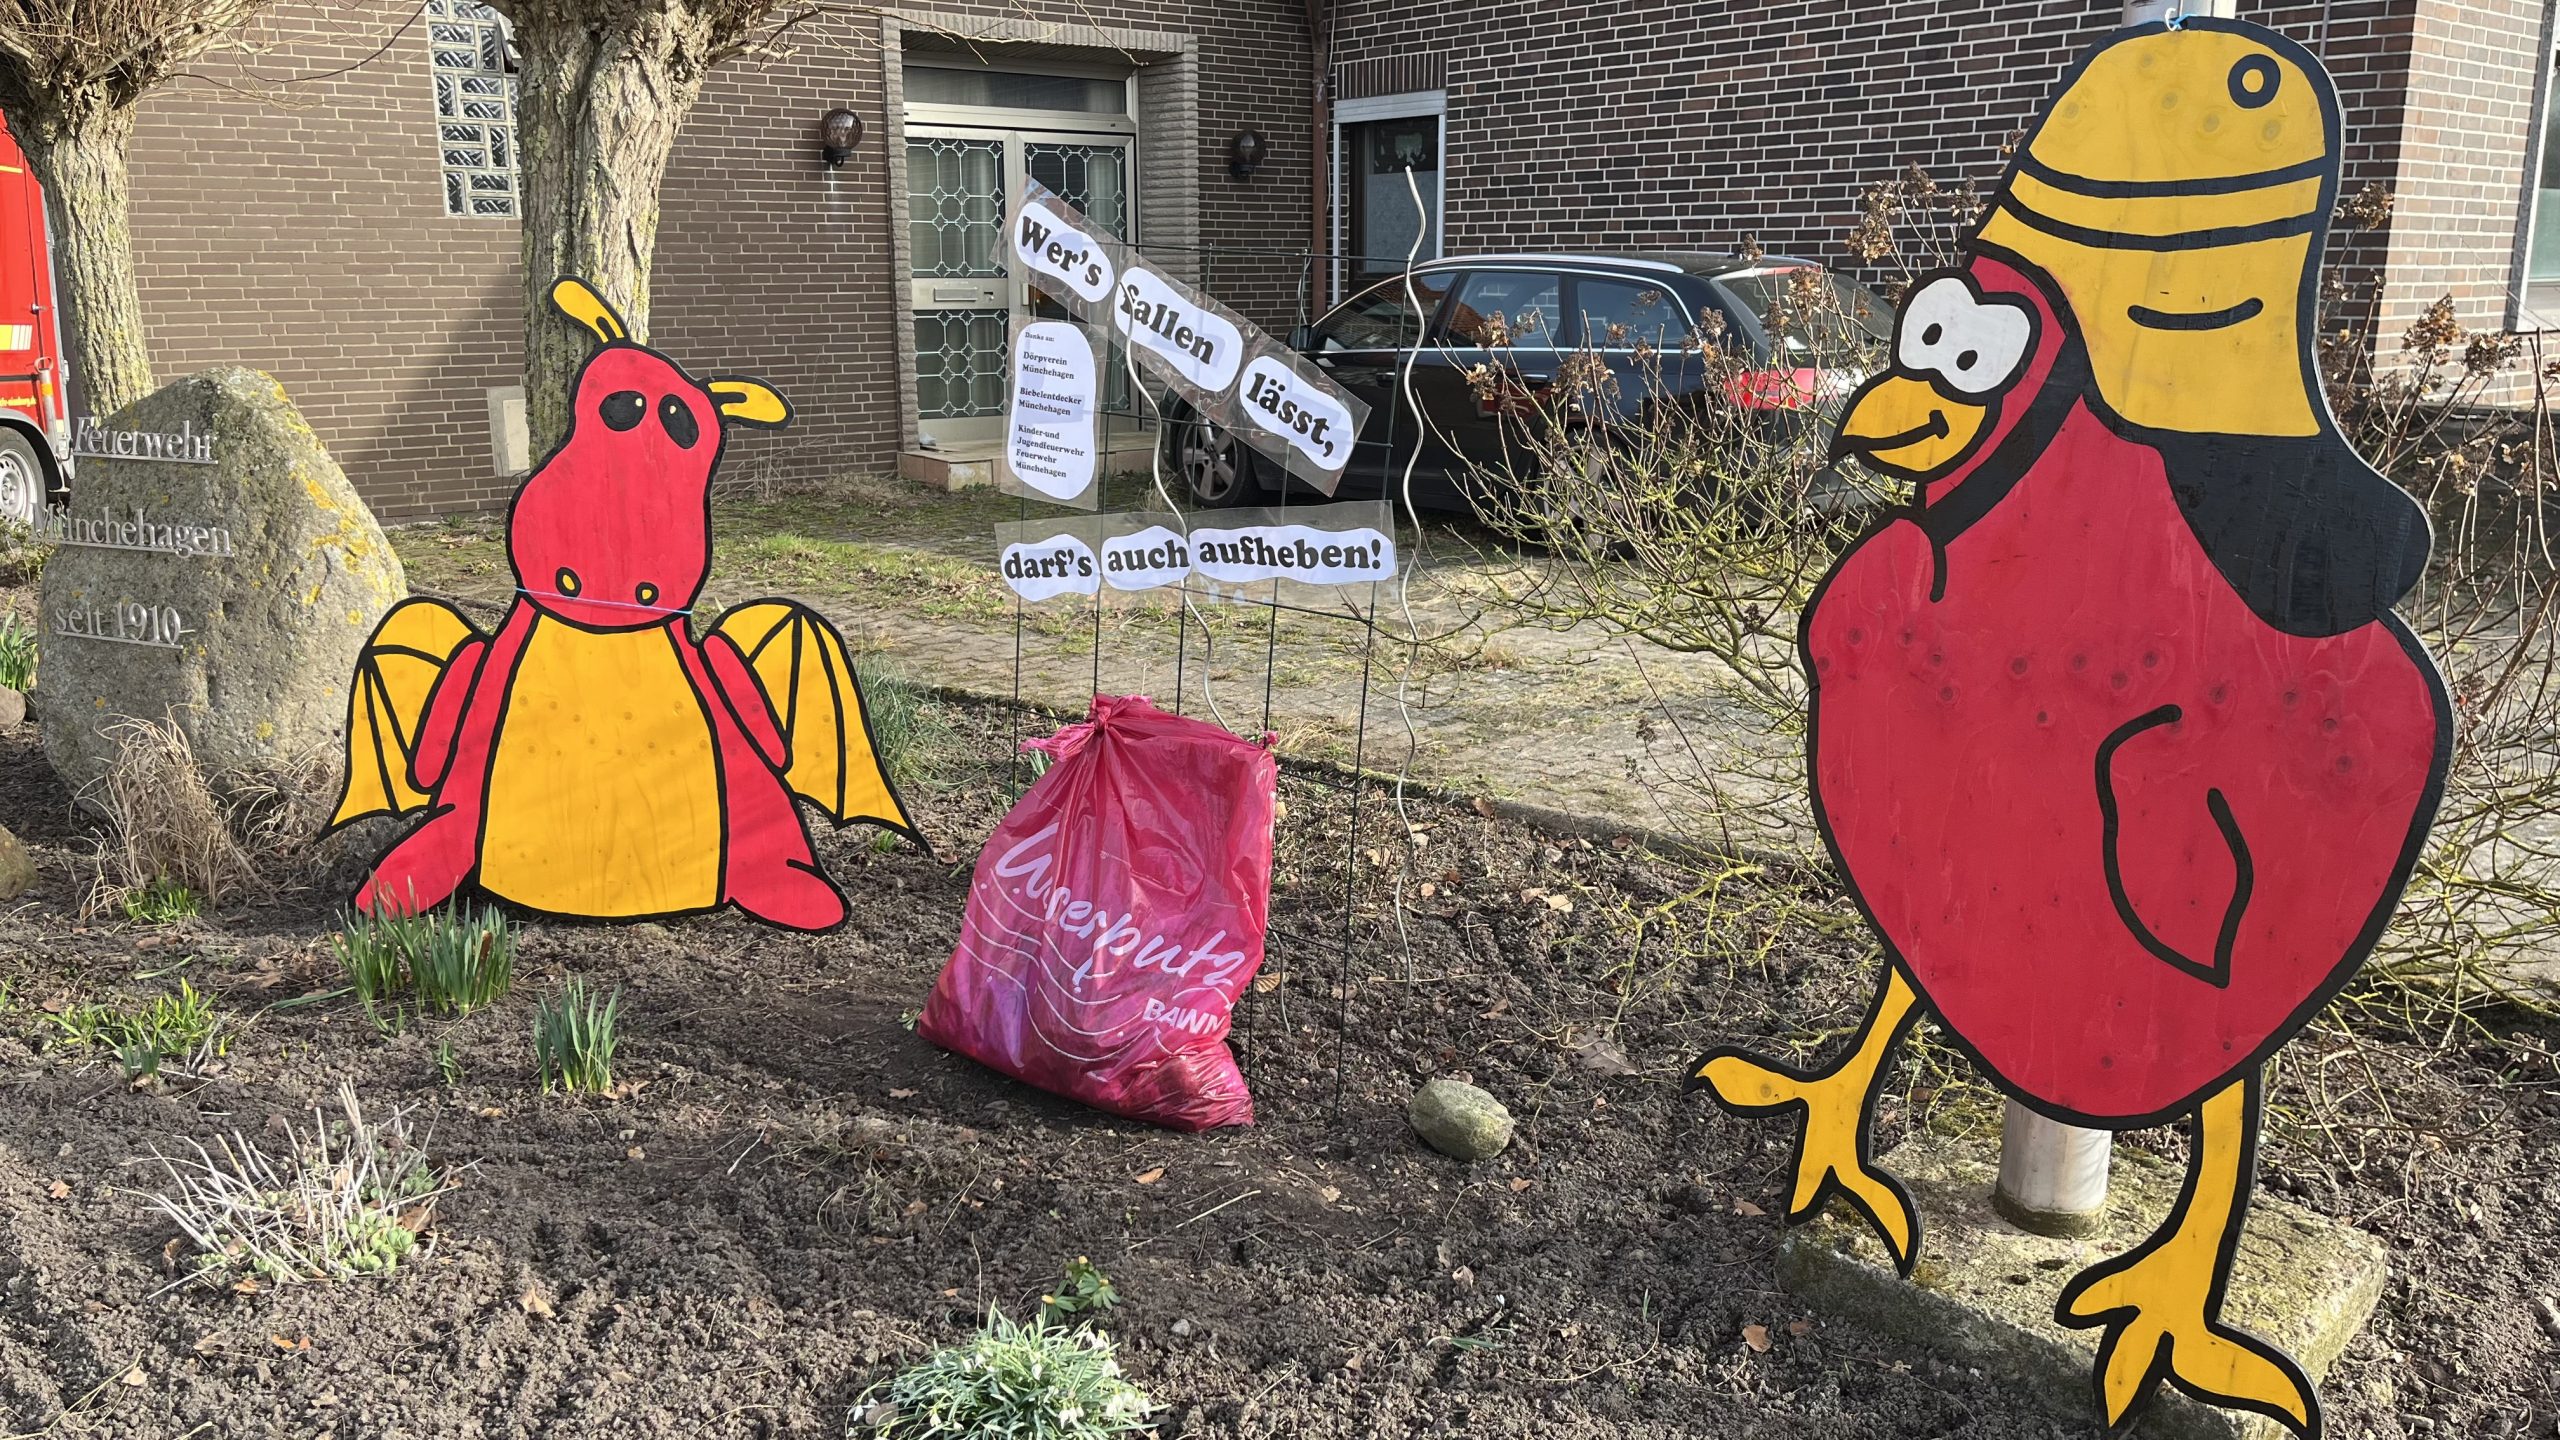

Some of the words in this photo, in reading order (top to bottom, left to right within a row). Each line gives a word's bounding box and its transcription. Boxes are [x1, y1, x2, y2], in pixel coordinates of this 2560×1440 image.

[1021, 215, 1102, 287] Wer's
[1120, 284, 1214, 365] fallen
[1246, 372, 1334, 458] lässt,
[1023, 351, 1067, 366] Dörpverein
[1022, 363, 1075, 379] Münchehagen
[1020, 386, 1082, 405] Biebelentdecker
[1018, 399, 1071, 416] Münchehagen
[74, 416, 213, 461] Feuerwehr
[1017, 436, 1085, 457] Jugendfeuerwehr
[1016, 448, 1058, 464] Feuerwehr
[1015, 460, 1067, 478] Münchehagen
[1004, 548, 1093, 580] darf's
[1108, 538, 1190, 573] auch
[1199, 535, 1382, 570] aufheben!
[55, 602, 105, 637] seit
[113, 601, 182, 646] 1910
[994, 821, 1246, 987] Wserputz
